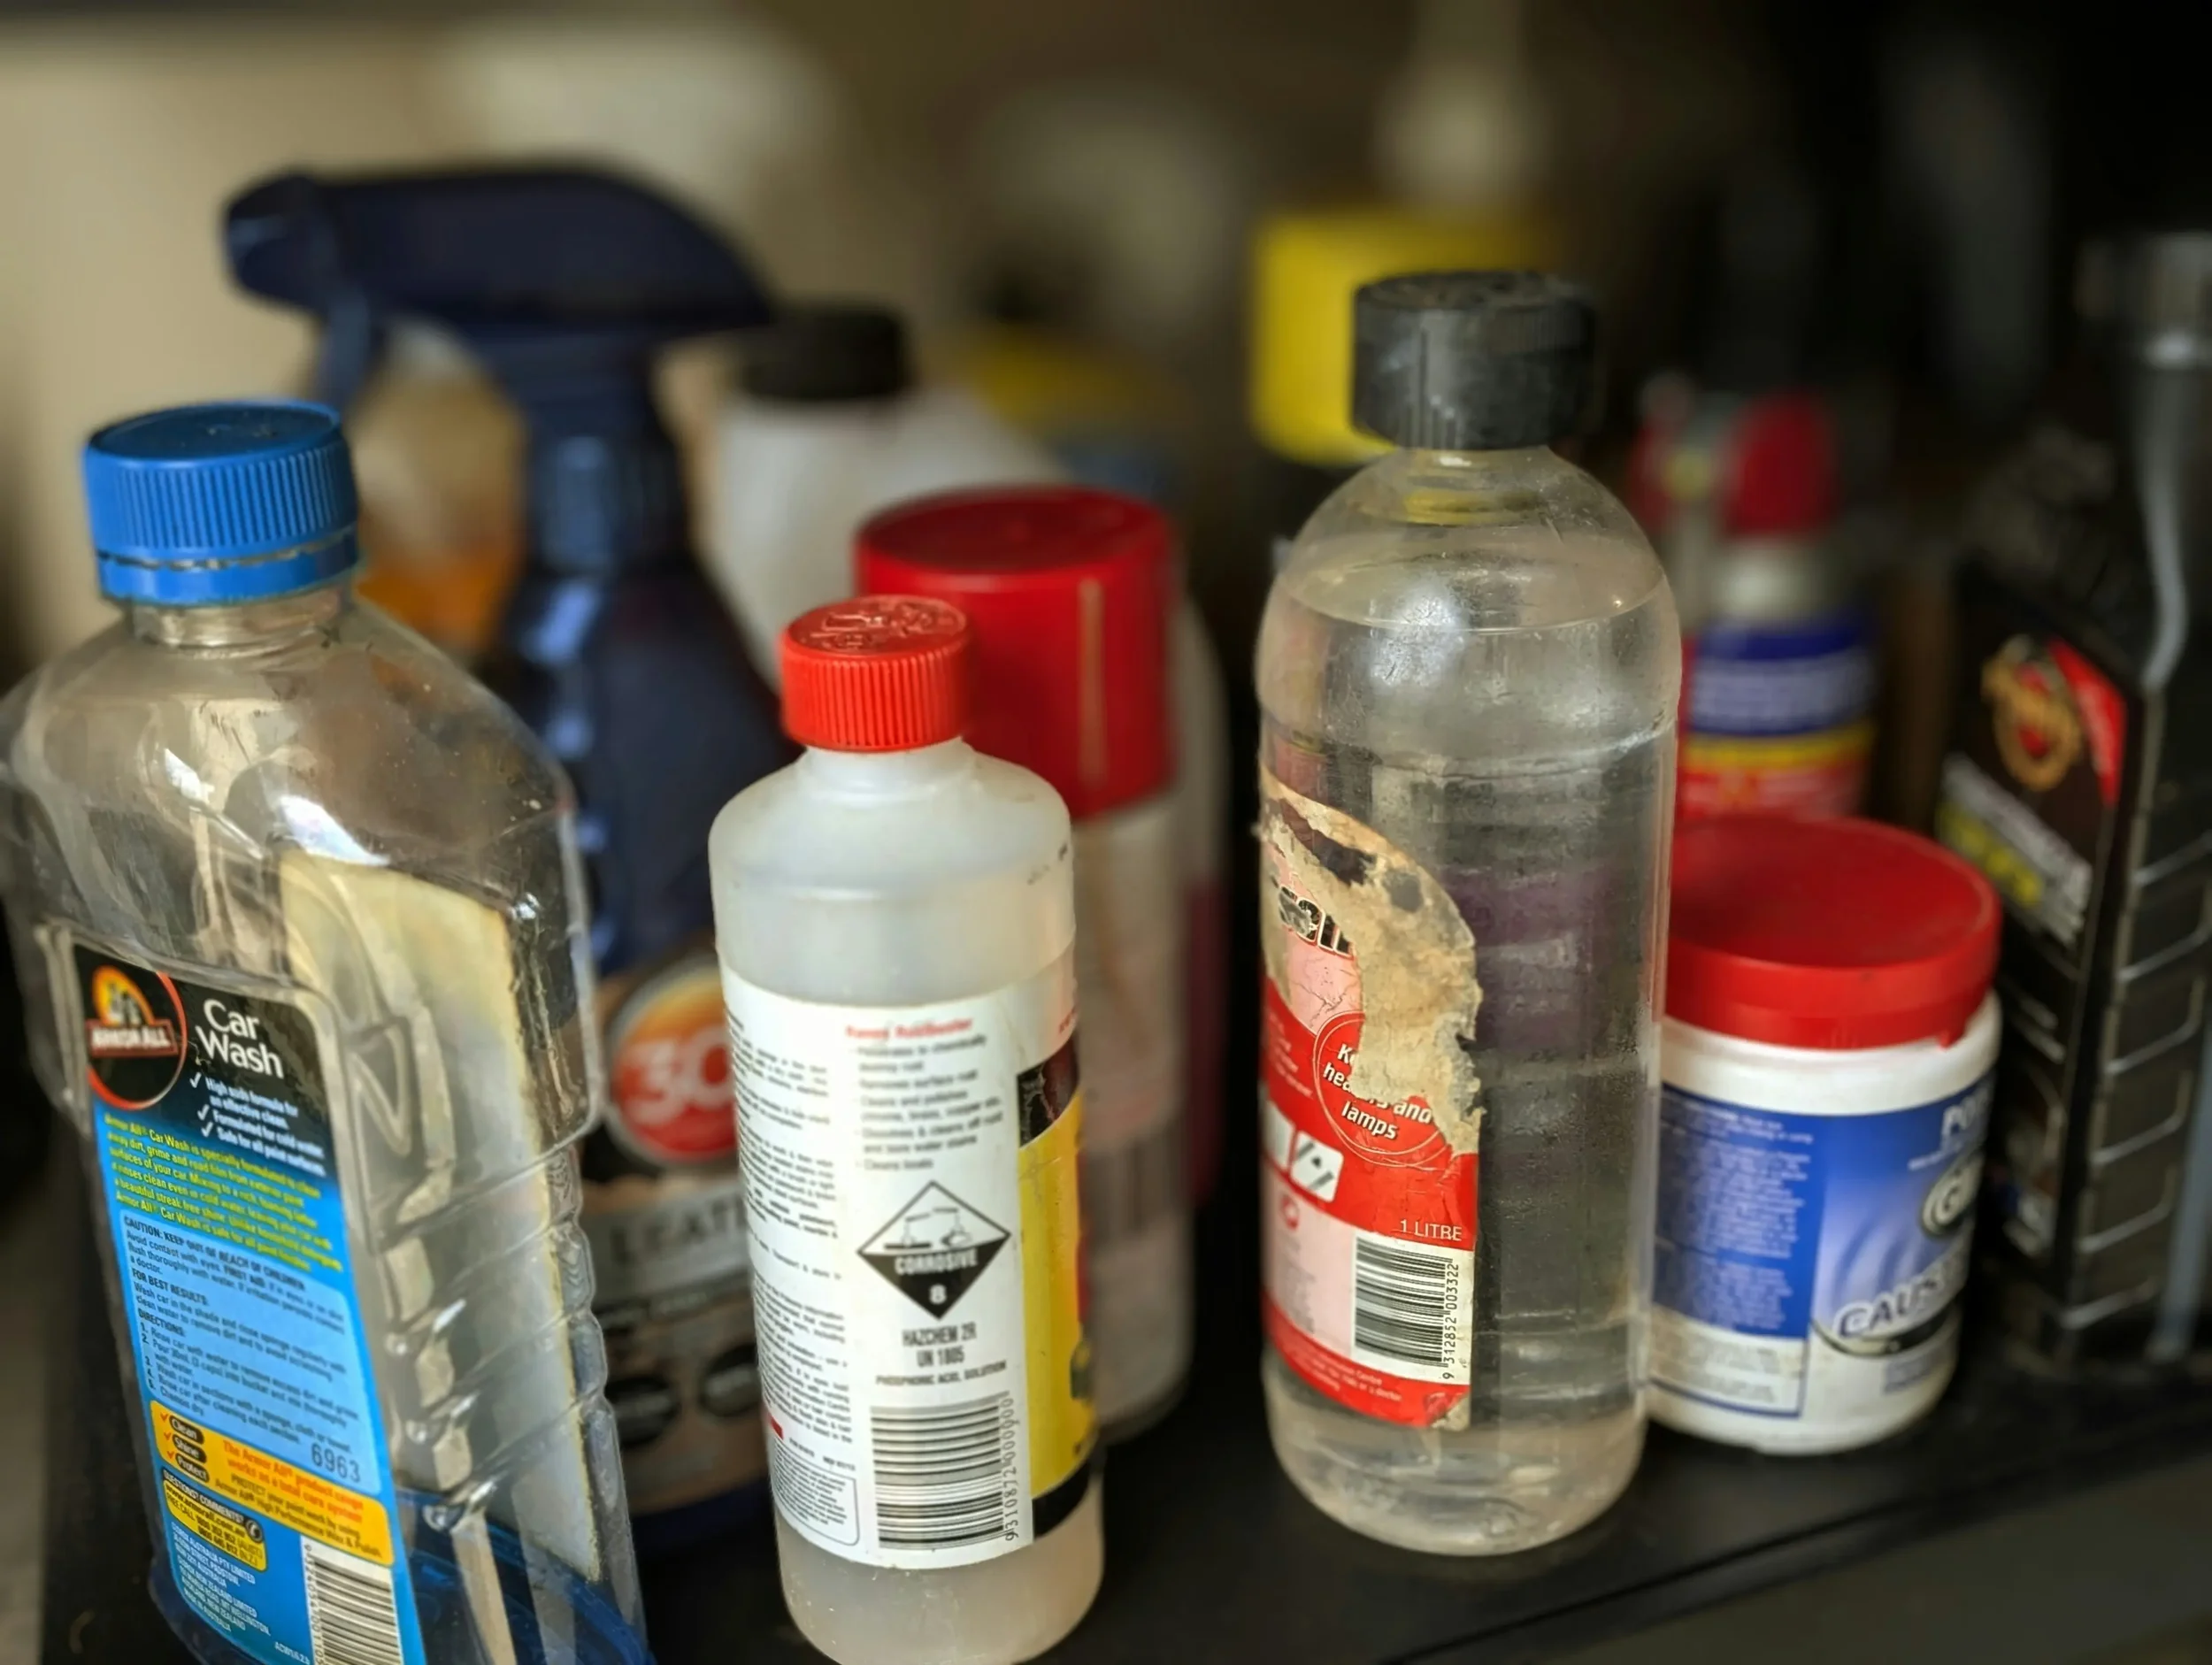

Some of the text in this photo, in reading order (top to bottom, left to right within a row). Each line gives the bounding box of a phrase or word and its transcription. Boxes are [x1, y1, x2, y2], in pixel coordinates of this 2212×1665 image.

[204, 999, 259, 1040] Car
[196, 1025, 284, 1078] Wash
[1341, 1101, 1400, 1140] lamps
[148, 1128, 189, 1153] Car Wash
[142, 1155, 152, 1170] of
[152, 1161, 172, 1178] your
[146, 1144, 172, 1163] grime
[171, 1152, 188, 1167] and
[119, 1178, 155, 1200] beautiful
[155, 1191, 182, 1209] streak
[142, 1171, 188, 1196] clean even
[159, 1205, 176, 1223] Car
[123, 1215, 164, 1239] CAUTION:
[163, 1230, 186, 1247] KEEP
[1400, 1218, 1463, 1241] 1 LITRE
[148, 1239, 180, 1258] contact
[135, 1256, 163, 1275] doctor.
[146, 1249, 189, 1275] thoroughly
[895, 1248, 978, 1276] CORROSIVE
[131, 1267, 148, 1283] FOR
[147, 1274, 169, 1293] BEST
[134, 1281, 155, 1299] Wash
[157, 1293, 170, 1305] car
[930, 1284, 947, 1304] 8
[140, 1321, 148, 1333] 1.
[902, 1325, 957, 1347] HAZCHEM
[917, 1349, 933, 1368] UN
[170, 1418, 198, 1439] Clean
[173, 1437, 199, 1458] Shine
[177, 1457, 207, 1481] Protect
[309, 1439, 363, 1486] 6963
[200, 1494, 244, 1524] COMMENTS?
